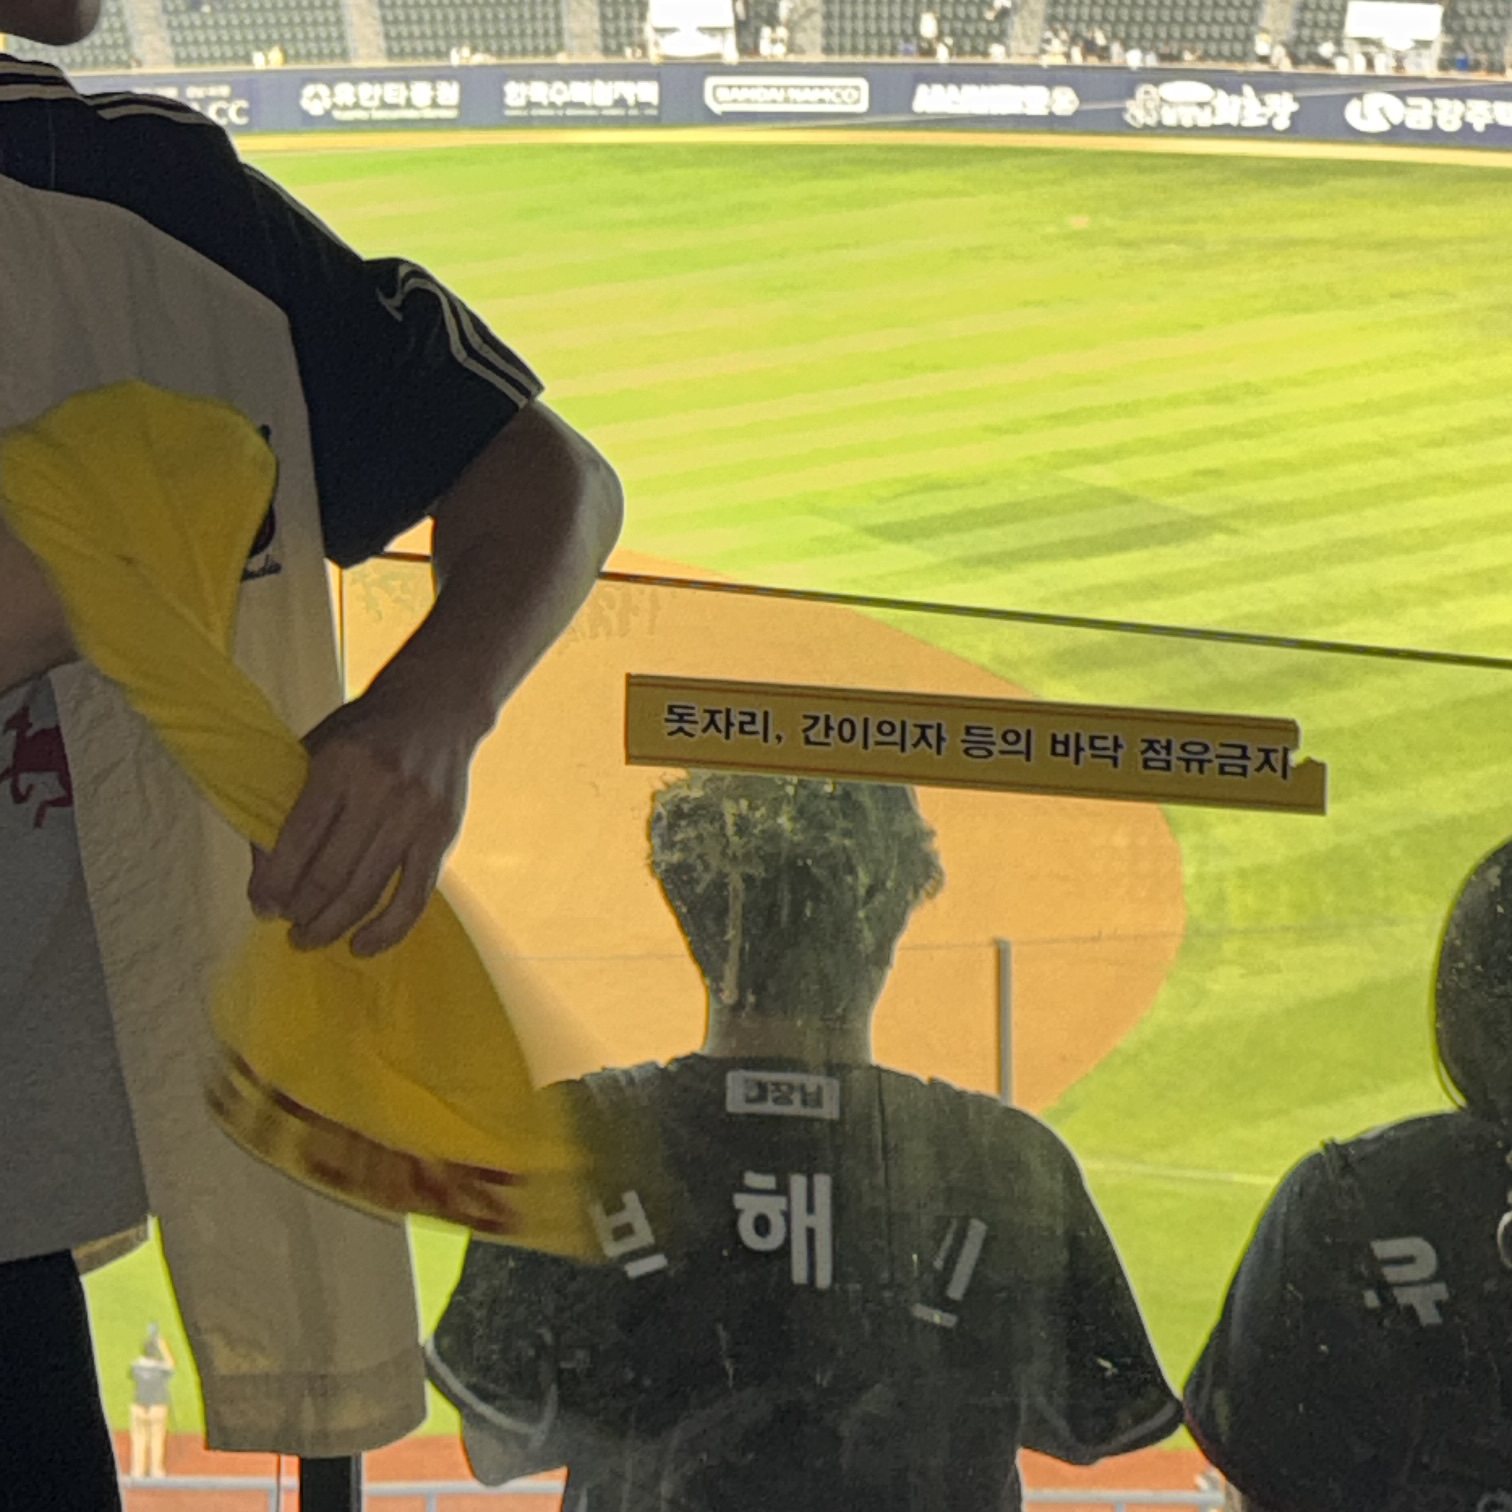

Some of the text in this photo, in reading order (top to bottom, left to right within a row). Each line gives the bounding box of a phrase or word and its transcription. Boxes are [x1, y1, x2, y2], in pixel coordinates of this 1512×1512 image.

[663, 701, 1291, 782] 돗자리, 간이의자 등의 바닥 점유금지
